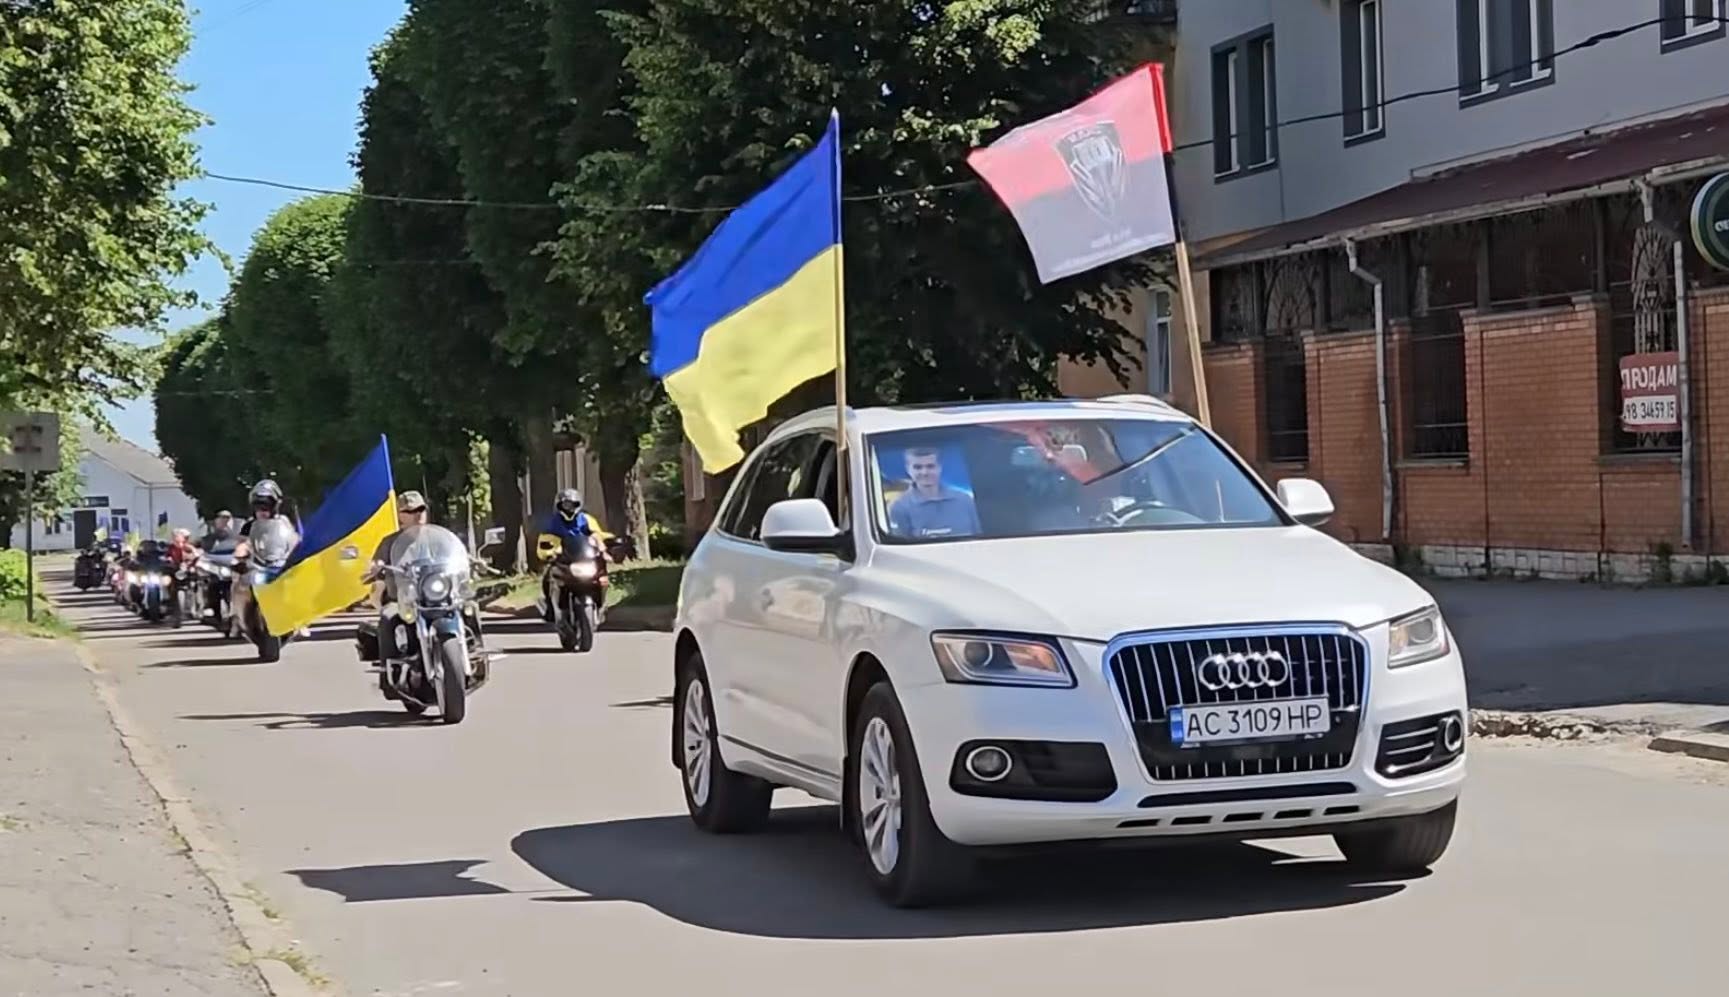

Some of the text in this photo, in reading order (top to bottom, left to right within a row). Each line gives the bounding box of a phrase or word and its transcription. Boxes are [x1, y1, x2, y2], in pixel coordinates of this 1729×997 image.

[1621, 365, 1677, 391] ПРОДАМ
[1623, 403, 1638, 420] 98
[1187, 704, 1322, 738] AC 3109 HP
